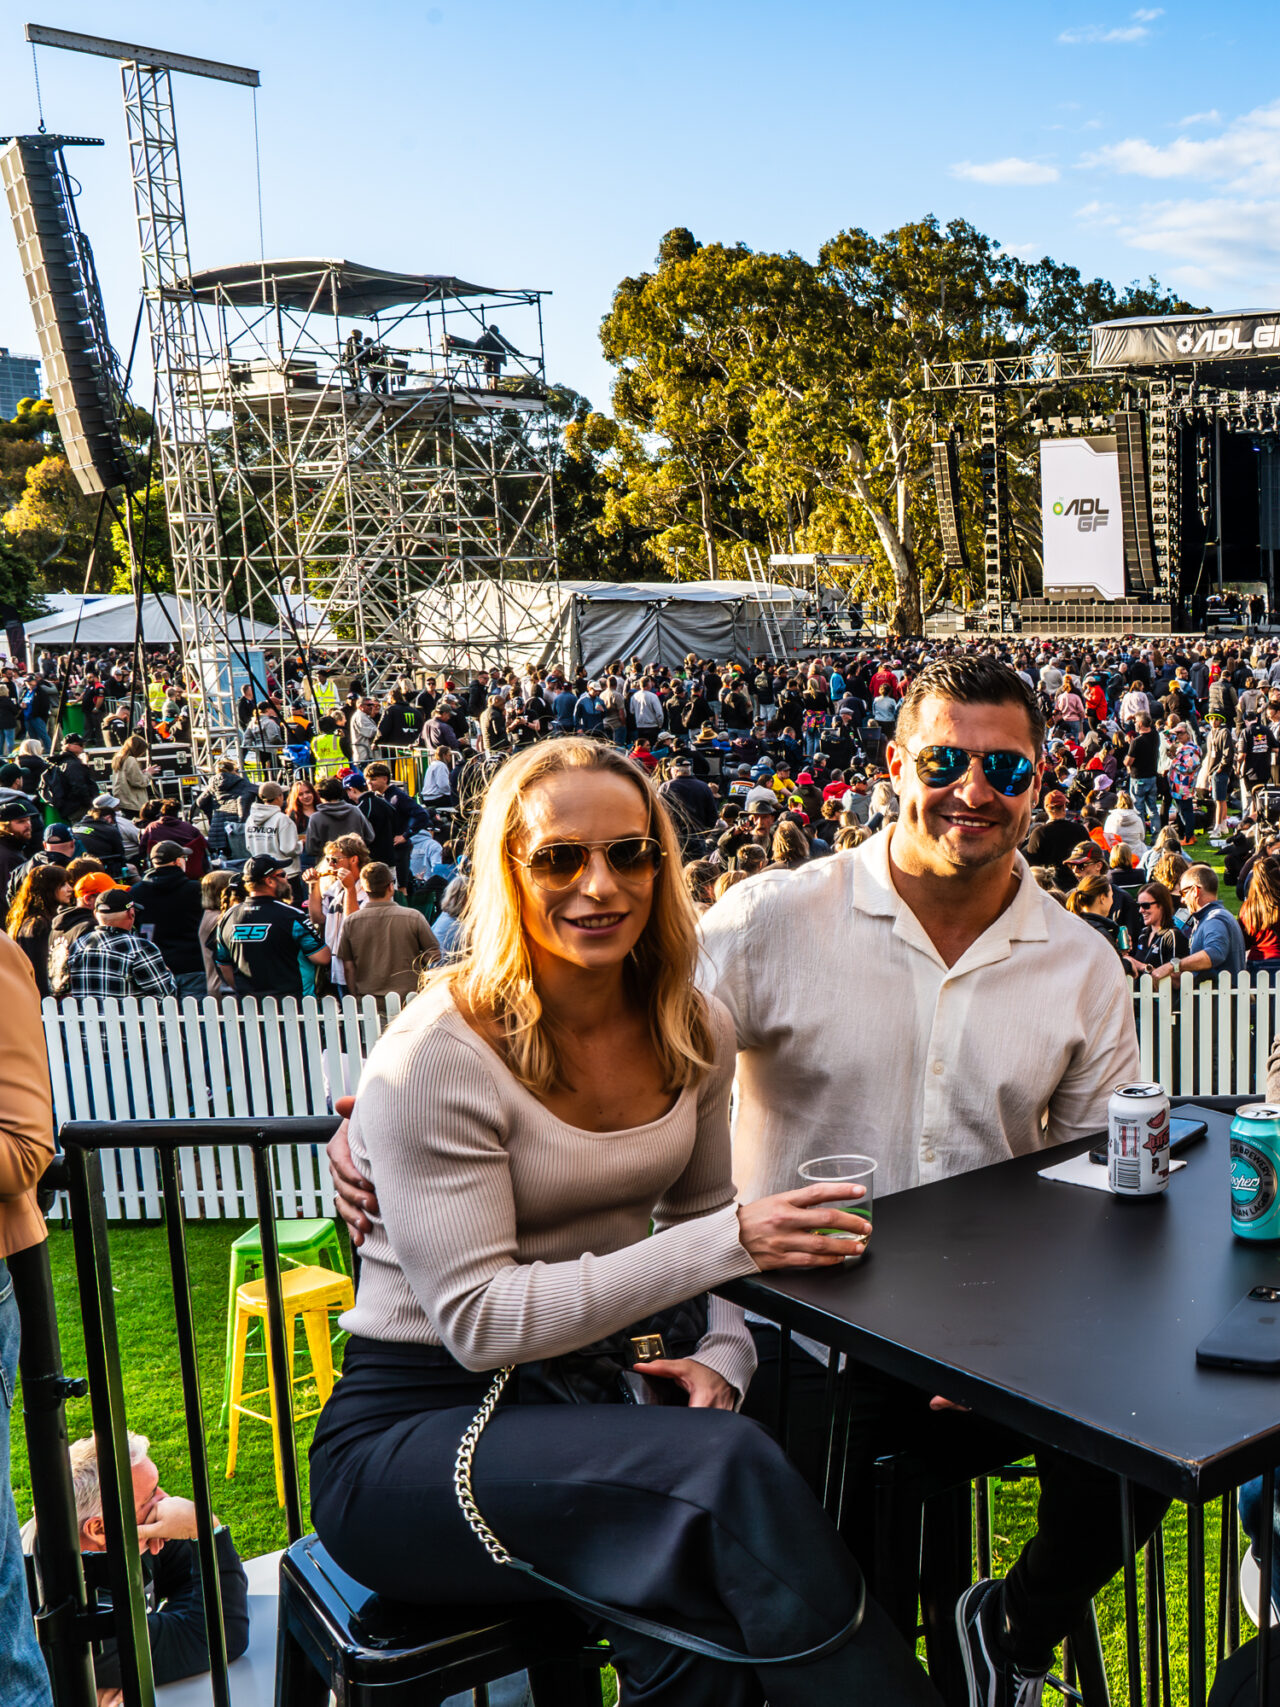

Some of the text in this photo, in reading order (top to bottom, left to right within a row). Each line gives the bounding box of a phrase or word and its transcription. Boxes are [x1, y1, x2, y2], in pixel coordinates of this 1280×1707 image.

[1191, 329, 1253, 353] ADL
[1064, 498, 1109, 516] ADL
[1077, 515, 1109, 532] GF
[233, 925, 268, 940] 25
[1239, 1145, 1272, 1177] BREWERY
